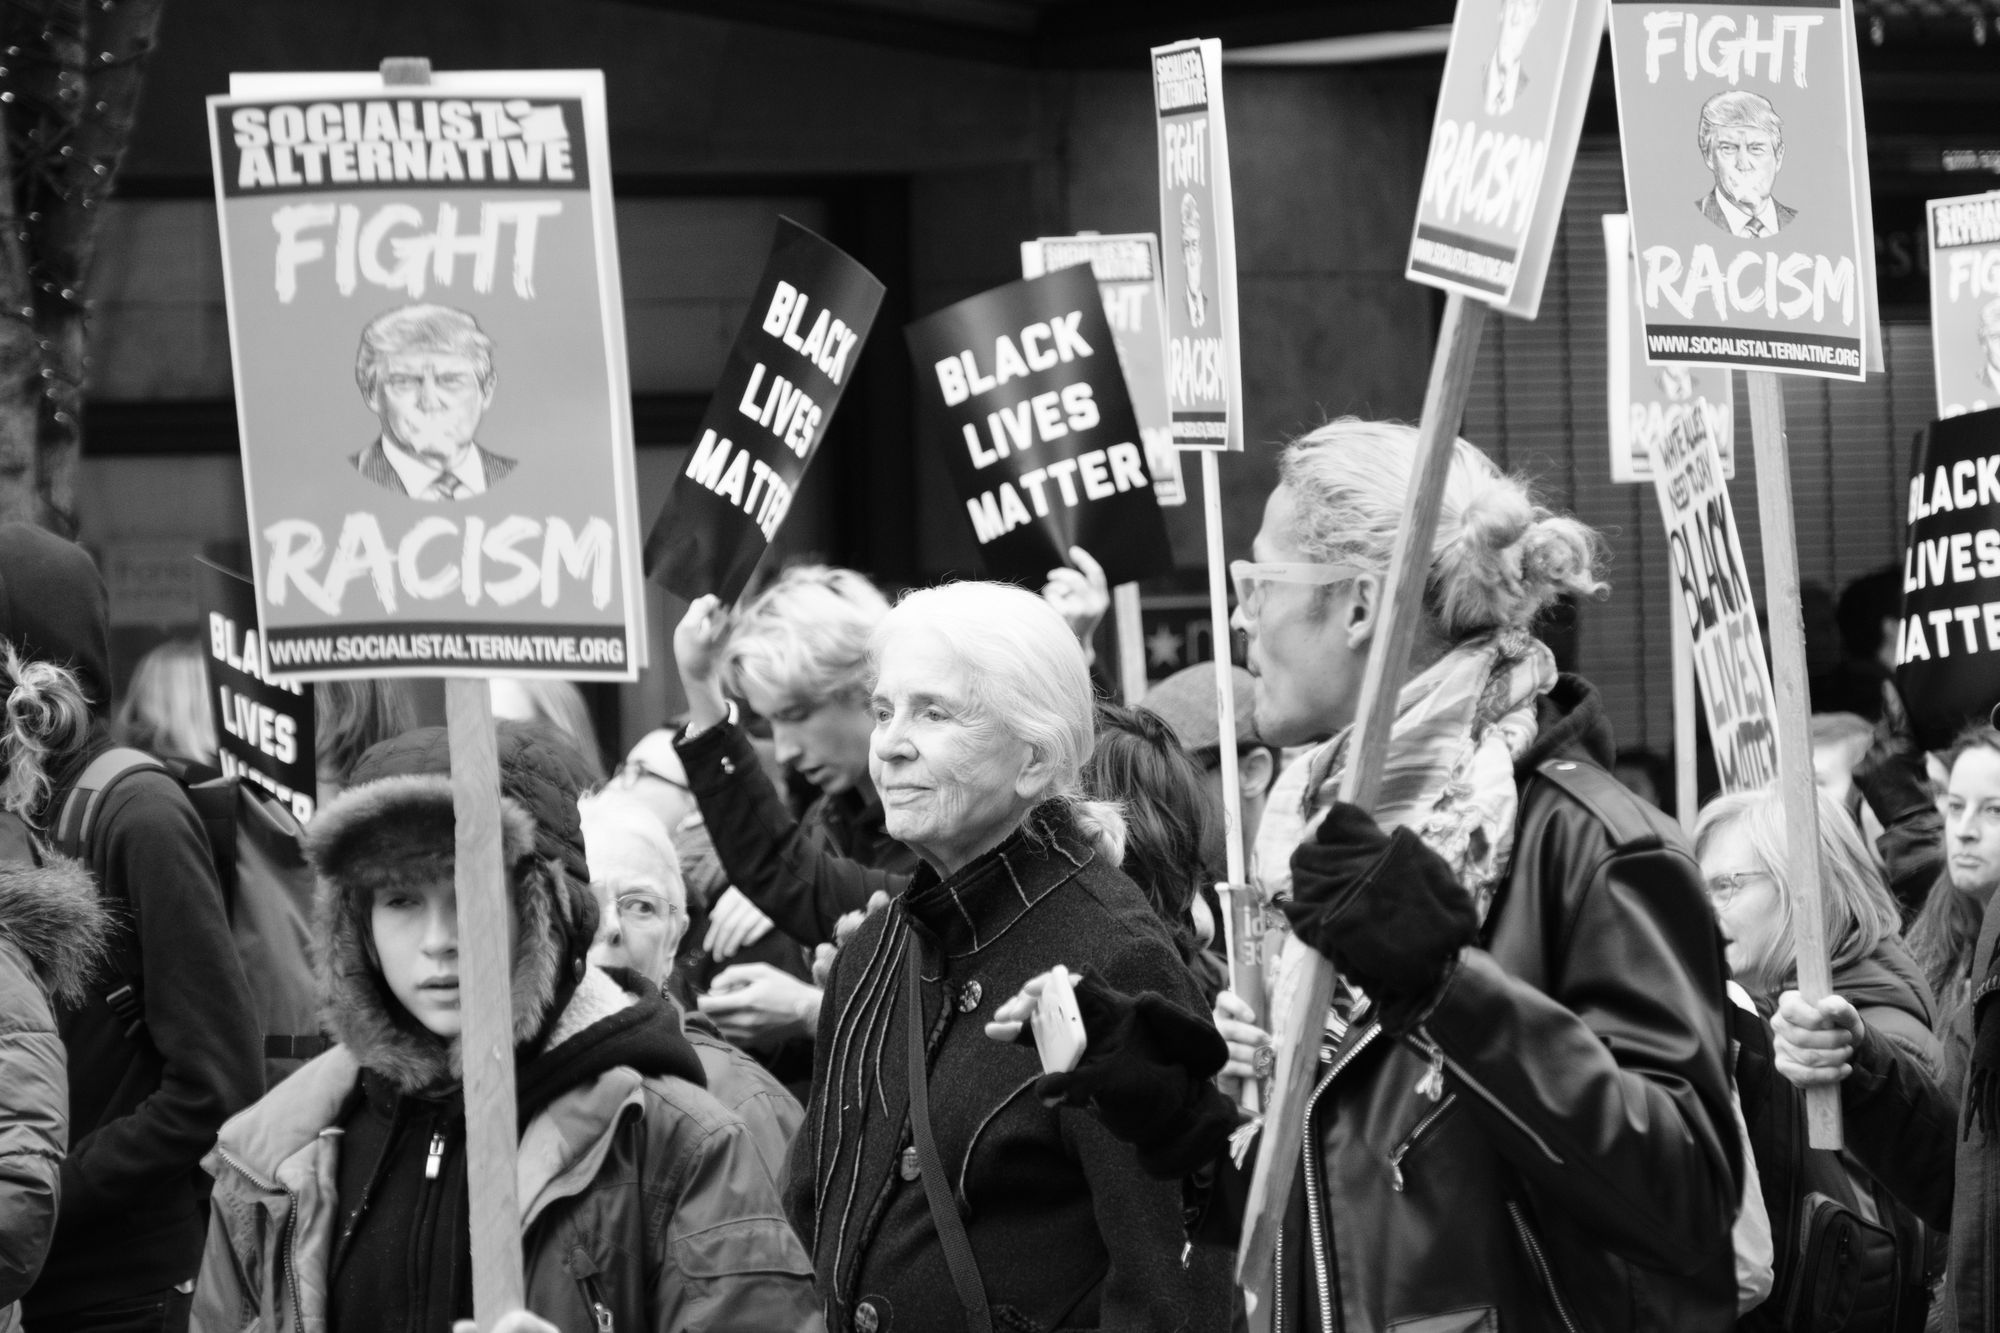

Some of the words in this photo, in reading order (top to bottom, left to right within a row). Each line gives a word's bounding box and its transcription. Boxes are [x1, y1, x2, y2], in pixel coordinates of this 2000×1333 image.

[1643, 10, 1824, 89] FIGHT
[232, 100, 508, 149] SOCIALIST
[236, 141, 574, 187] ALTERNATIVE
[271, 200, 563, 303] FIGHT
[1642, 243, 1855, 327] RACISM
[762, 280, 859, 386] BLACK
[934, 310, 1094, 407] BLACK
[1648, 335, 1860, 368] WWW.SOCIALISTALTERNATIVE.ORG
[738, 362, 823, 459] LIVES
[962, 381, 1100, 470] LIVES
[966, 441, 1149, 544] MATTER
[262, 511, 613, 617] RACISM
[1670, 490, 1748, 643] BLACK
[1904, 528, 2000, 594] LIVES
[209, 611, 304, 696] BLA
[268, 635, 625, 665] WWW.SOCIALISTALTERNATIVE.ORG
[1699, 610, 1770, 735] LIVES
[220, 685, 298, 765] LIVES
